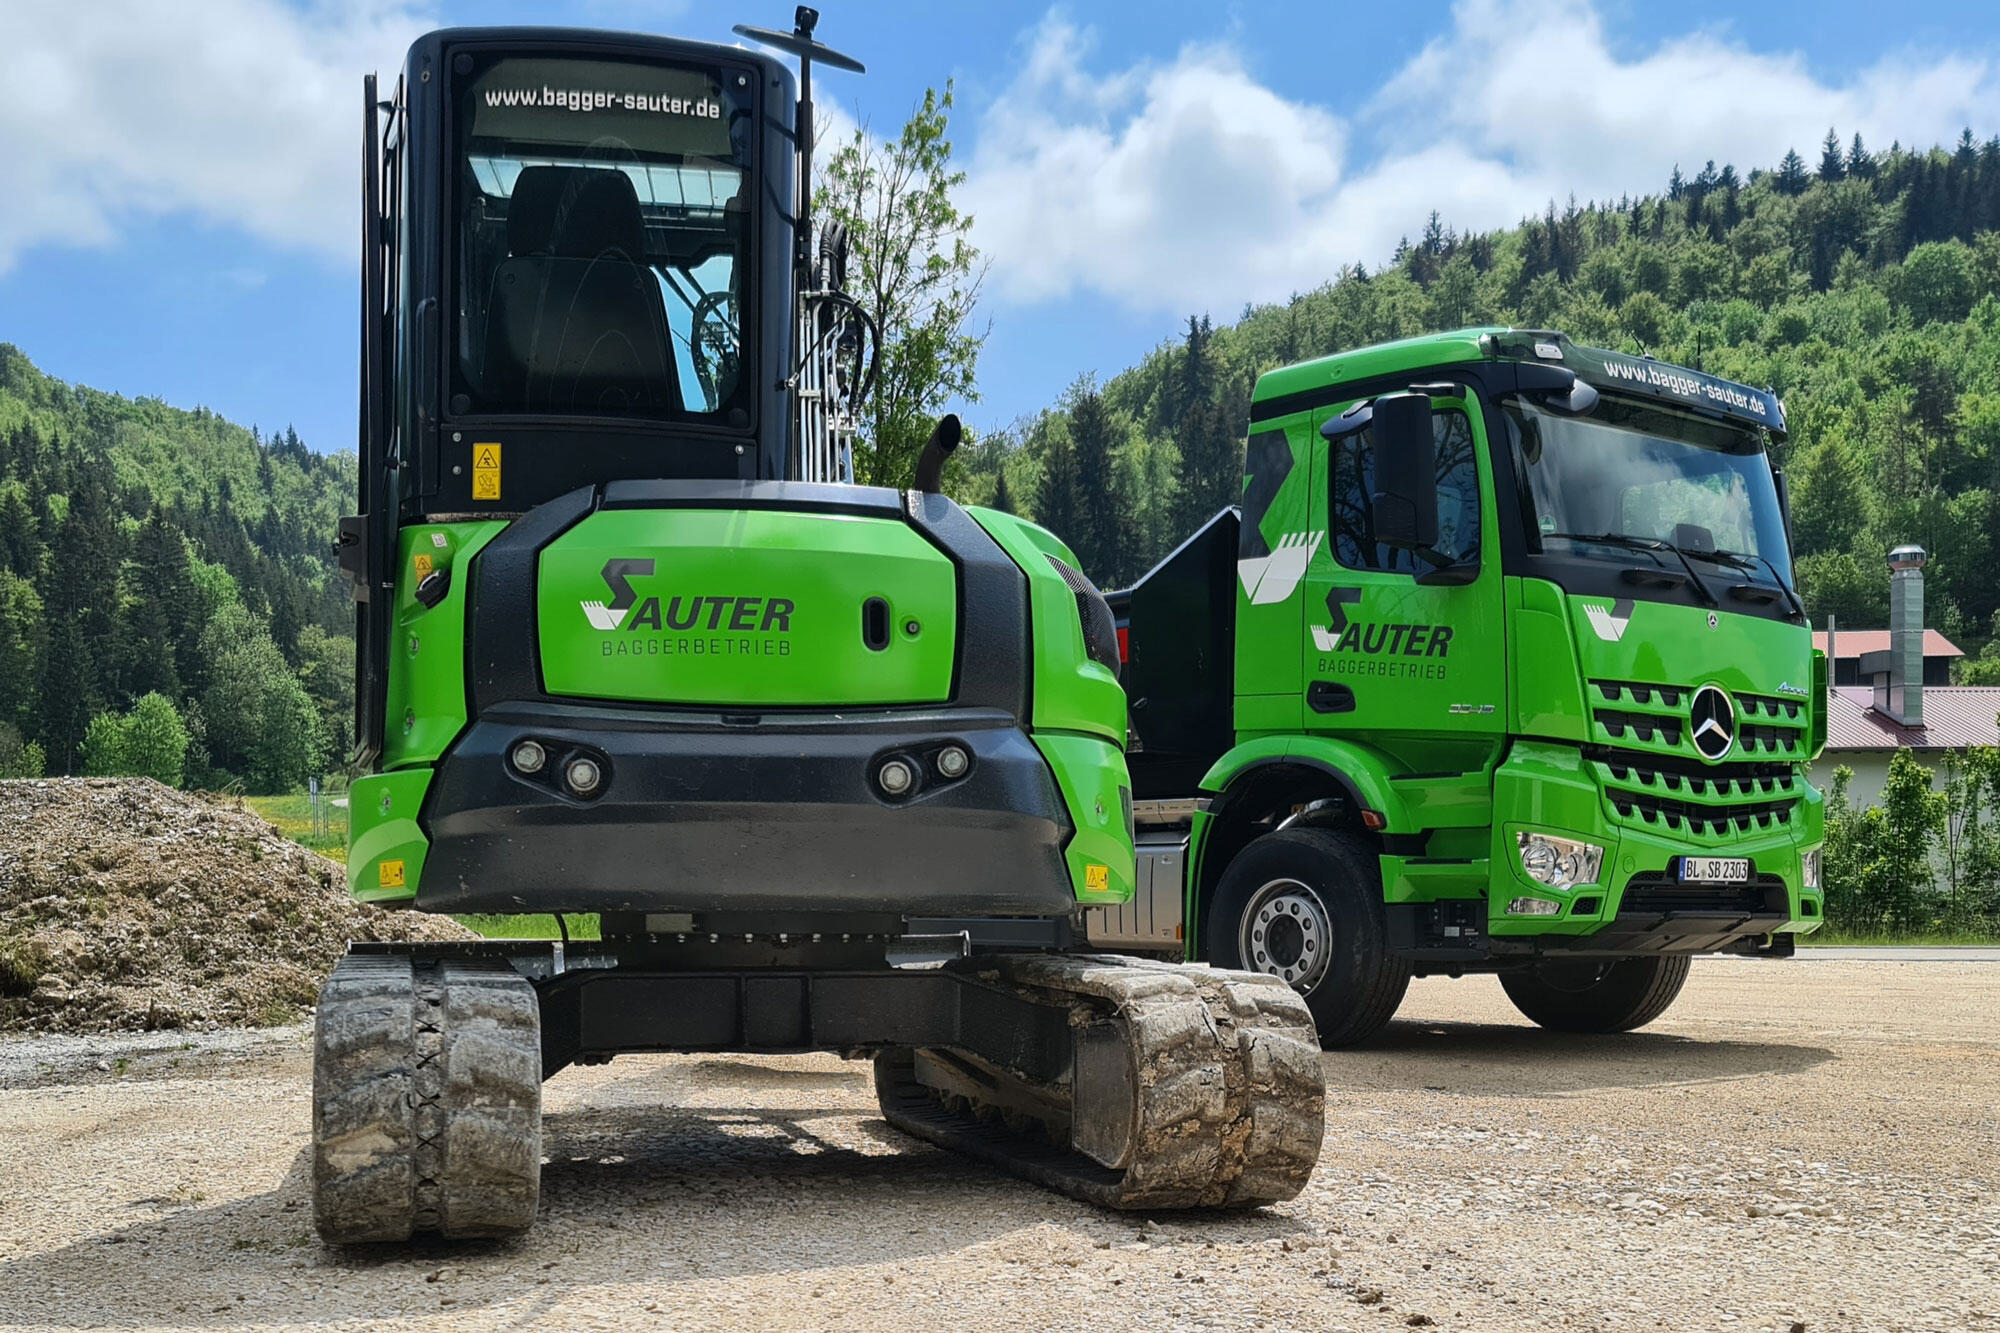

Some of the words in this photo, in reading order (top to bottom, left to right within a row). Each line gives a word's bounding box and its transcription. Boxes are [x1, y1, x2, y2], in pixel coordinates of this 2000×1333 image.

[485, 84, 720, 119] www.bagger-sauter.de
[1604, 361, 1766, 416] www.bagger-sauter.de
[580, 558, 795, 632] SAUTER
[1310, 586, 1454, 658] SAUTER
[602, 638, 791, 656] BAGGERBETRIEB
[1318, 658, 1447, 680] BAGGERBETRIEB
[1686, 860, 1700, 878] BL
[1708, 861, 1721, 879] SB
[1723, 861, 1747, 879] 2303
